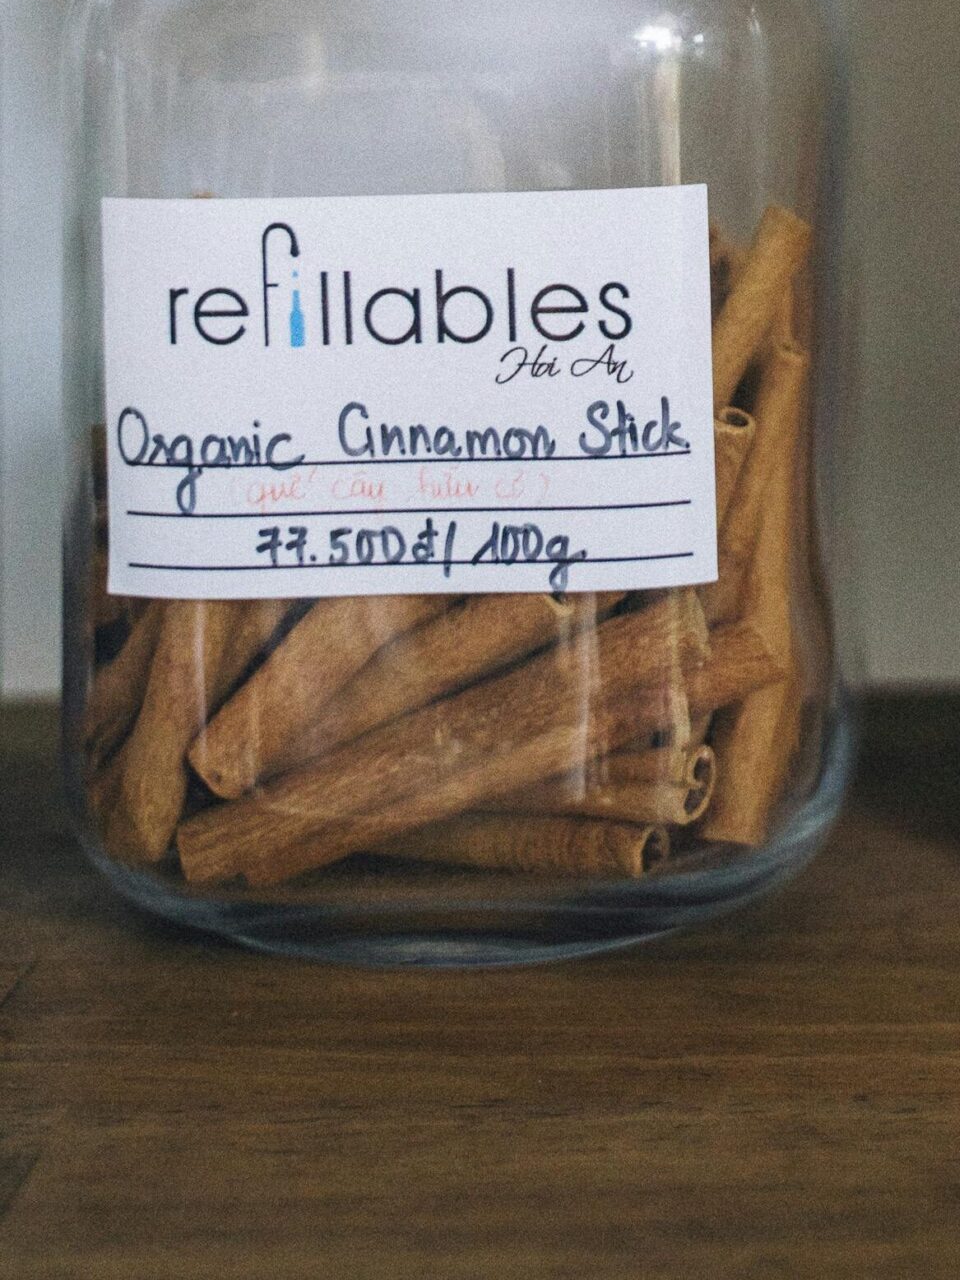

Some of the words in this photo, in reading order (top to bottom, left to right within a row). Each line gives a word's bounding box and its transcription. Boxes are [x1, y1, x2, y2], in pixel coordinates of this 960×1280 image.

[170, 222, 633, 347] refillables
[495, 344, 561, 384] Hoi
[570, 343, 634, 384] An
[117, 406, 305, 516] Organic
[338, 401, 556, 459] Cinnamon
[578, 396, 691, 457] Stick
